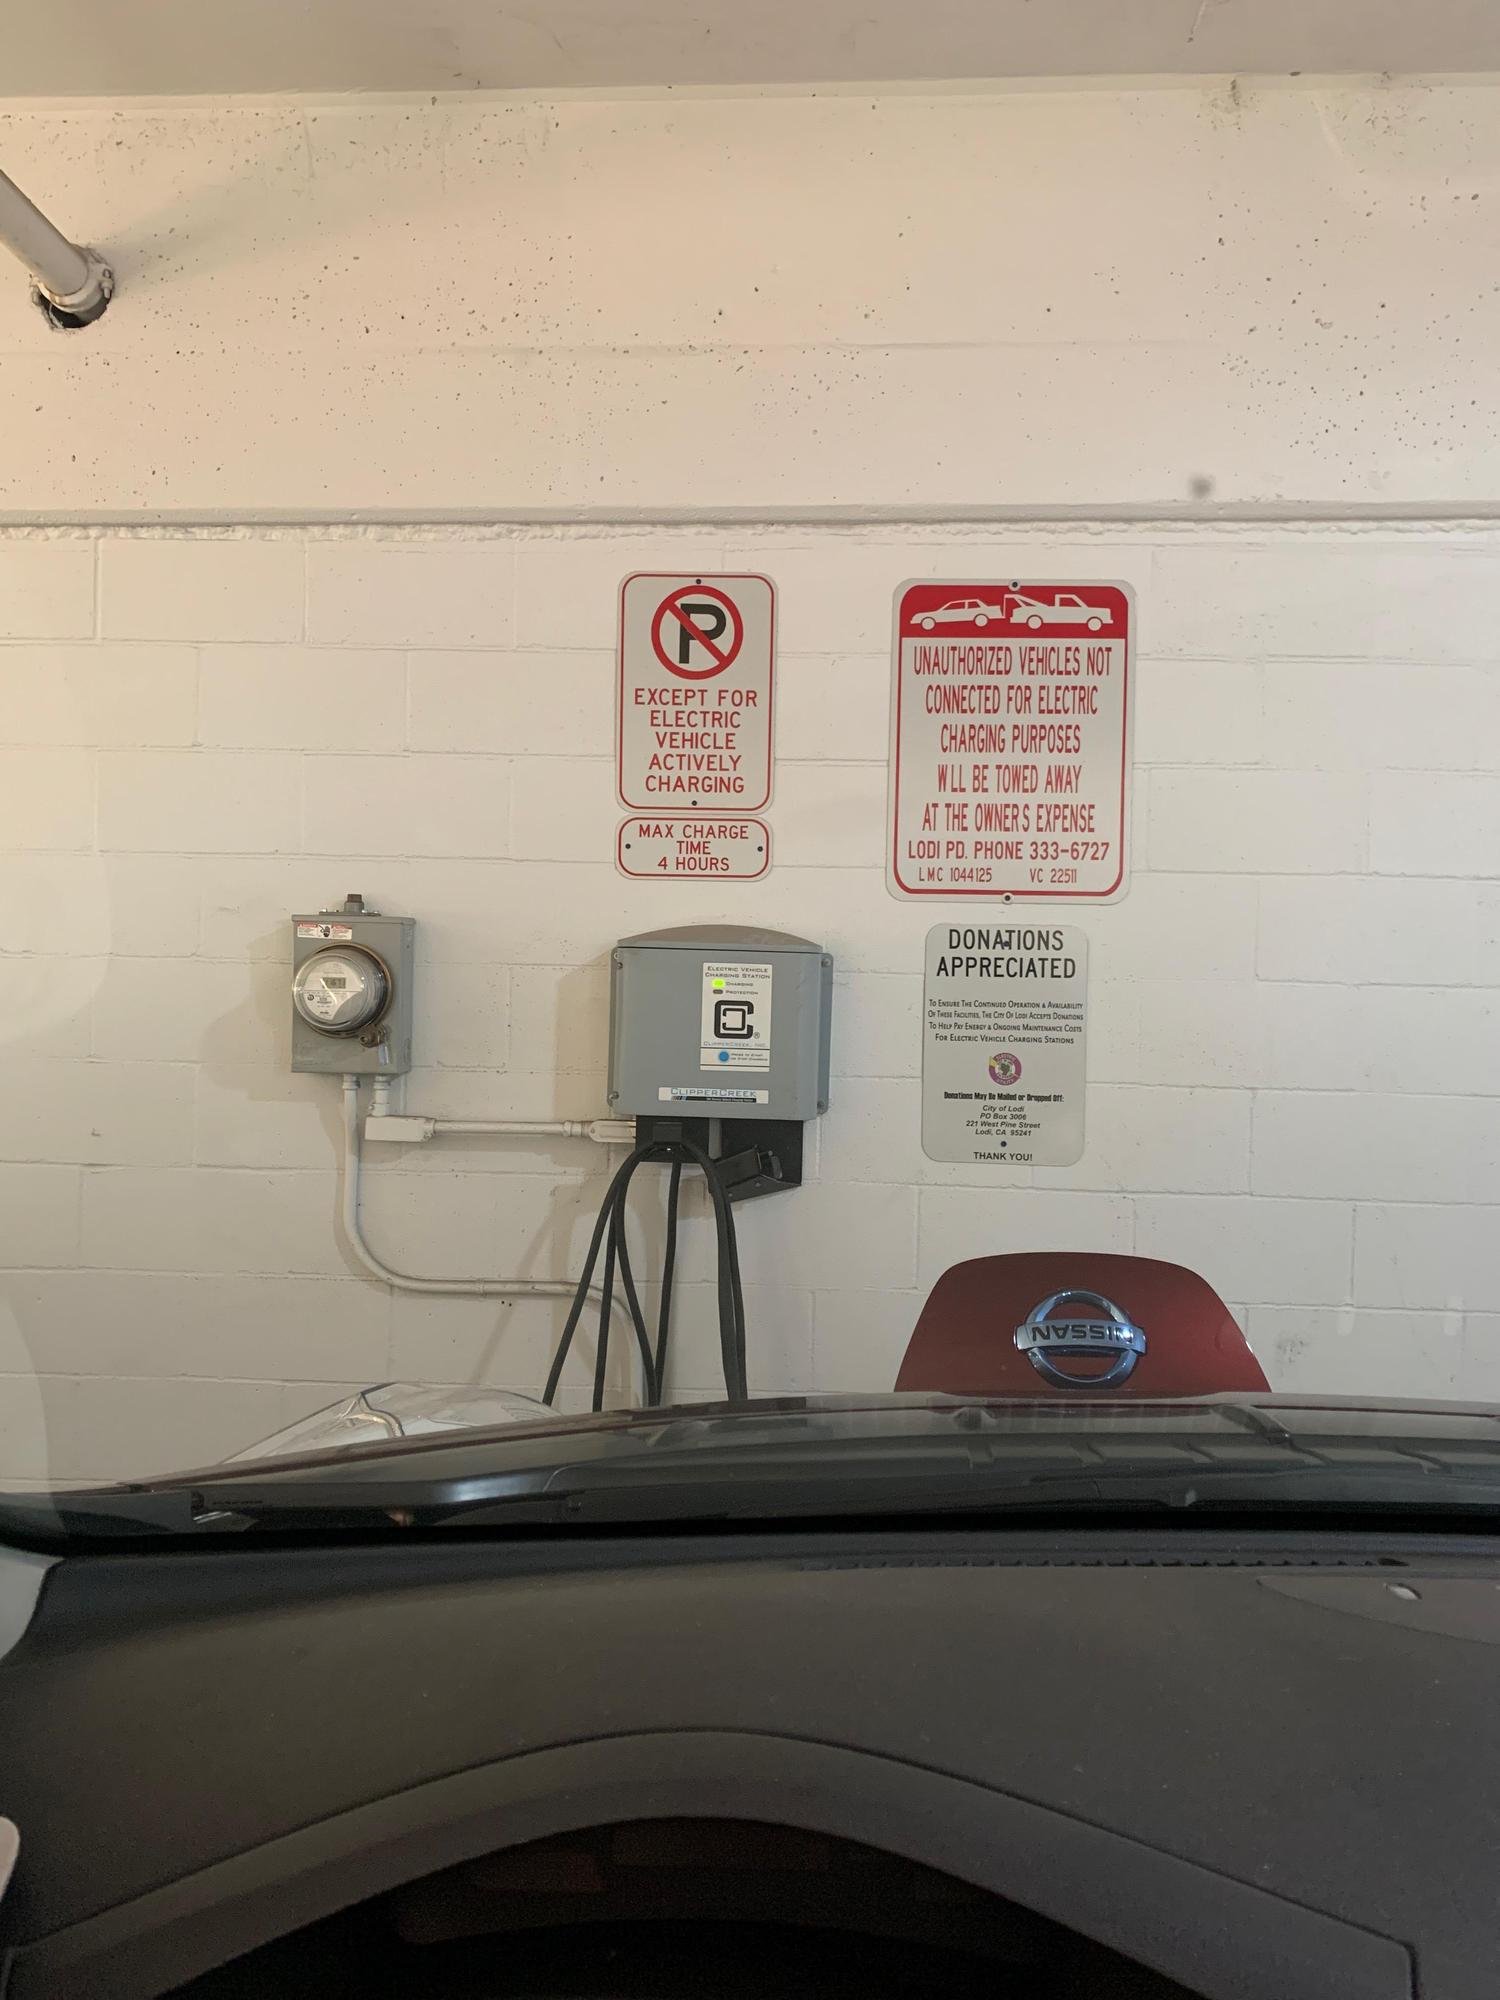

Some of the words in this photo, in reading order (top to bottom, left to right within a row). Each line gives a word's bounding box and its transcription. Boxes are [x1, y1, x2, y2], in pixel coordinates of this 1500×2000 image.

[914, 646, 1013, 675] UNAUTHORIZED
[1019, 646, 1081, 676] VEHICLES
[1086, 647, 1112, 676] NOT
[634, 688, 708, 706] EXCEPT
[718, 689, 758, 707] FOR
[926, 685, 1000, 714] CONNECTED
[1007, 685, 1032, 714] FOR
[1038, 685, 1098, 715] ELECTRIC
[650, 710, 741, 729] ELECTRIC
[655, 732, 736, 750] VEHICLE
[941, 724, 1006, 753] CHARGING
[1012, 724, 1081, 753] PURPOSES
[649, 754, 742, 771] ACTIVELY
[645, 775, 744, 793] CHARGING
[972, 764, 989, 793] BE
[995, 764, 1039, 793] TOWED
[1044, 765, 1082, 794] AWAY
[922, 803, 939, 831] AT
[945, 803, 969, 831] THE
[1036, 804, 1096, 833] EXPENSE
[638, 824, 674, 839] MAX
[682, 825, 749, 840] CHARGE
[676, 841, 711, 855] TIME
[908, 840, 940, 859] LODI
[946, 840, 968, 859] PD.
[974, 841, 1023, 860] PHONE
[1029, 841, 1110, 861] 333-6727
[657, 857, 668, 870] 4
[676, 857, 730, 871] HOURS
[950, 867, 993, 883] 1044125
[1029, 868, 1044, 883] VC
[1050, 868, 1077, 883] 22511
[949, 928, 1064, 951] DONATIONS
[936, 956, 1076, 979] APPRECIATED
[944, 1091, 973, 1100] Donations
[974, 1092, 987, 1101] May
[988, 1092, 996, 1100] Be
[997, 1092, 1017, 1101] Mailed
[1026, 1094, 1052, 1103] Dropped
[982, 1105, 997, 1113] City
[973, 1151, 1007, 1160] THANK
[1009, 1152, 1033, 1161] YOU!
[1032, 1323, 1133, 1344] NISSAN
